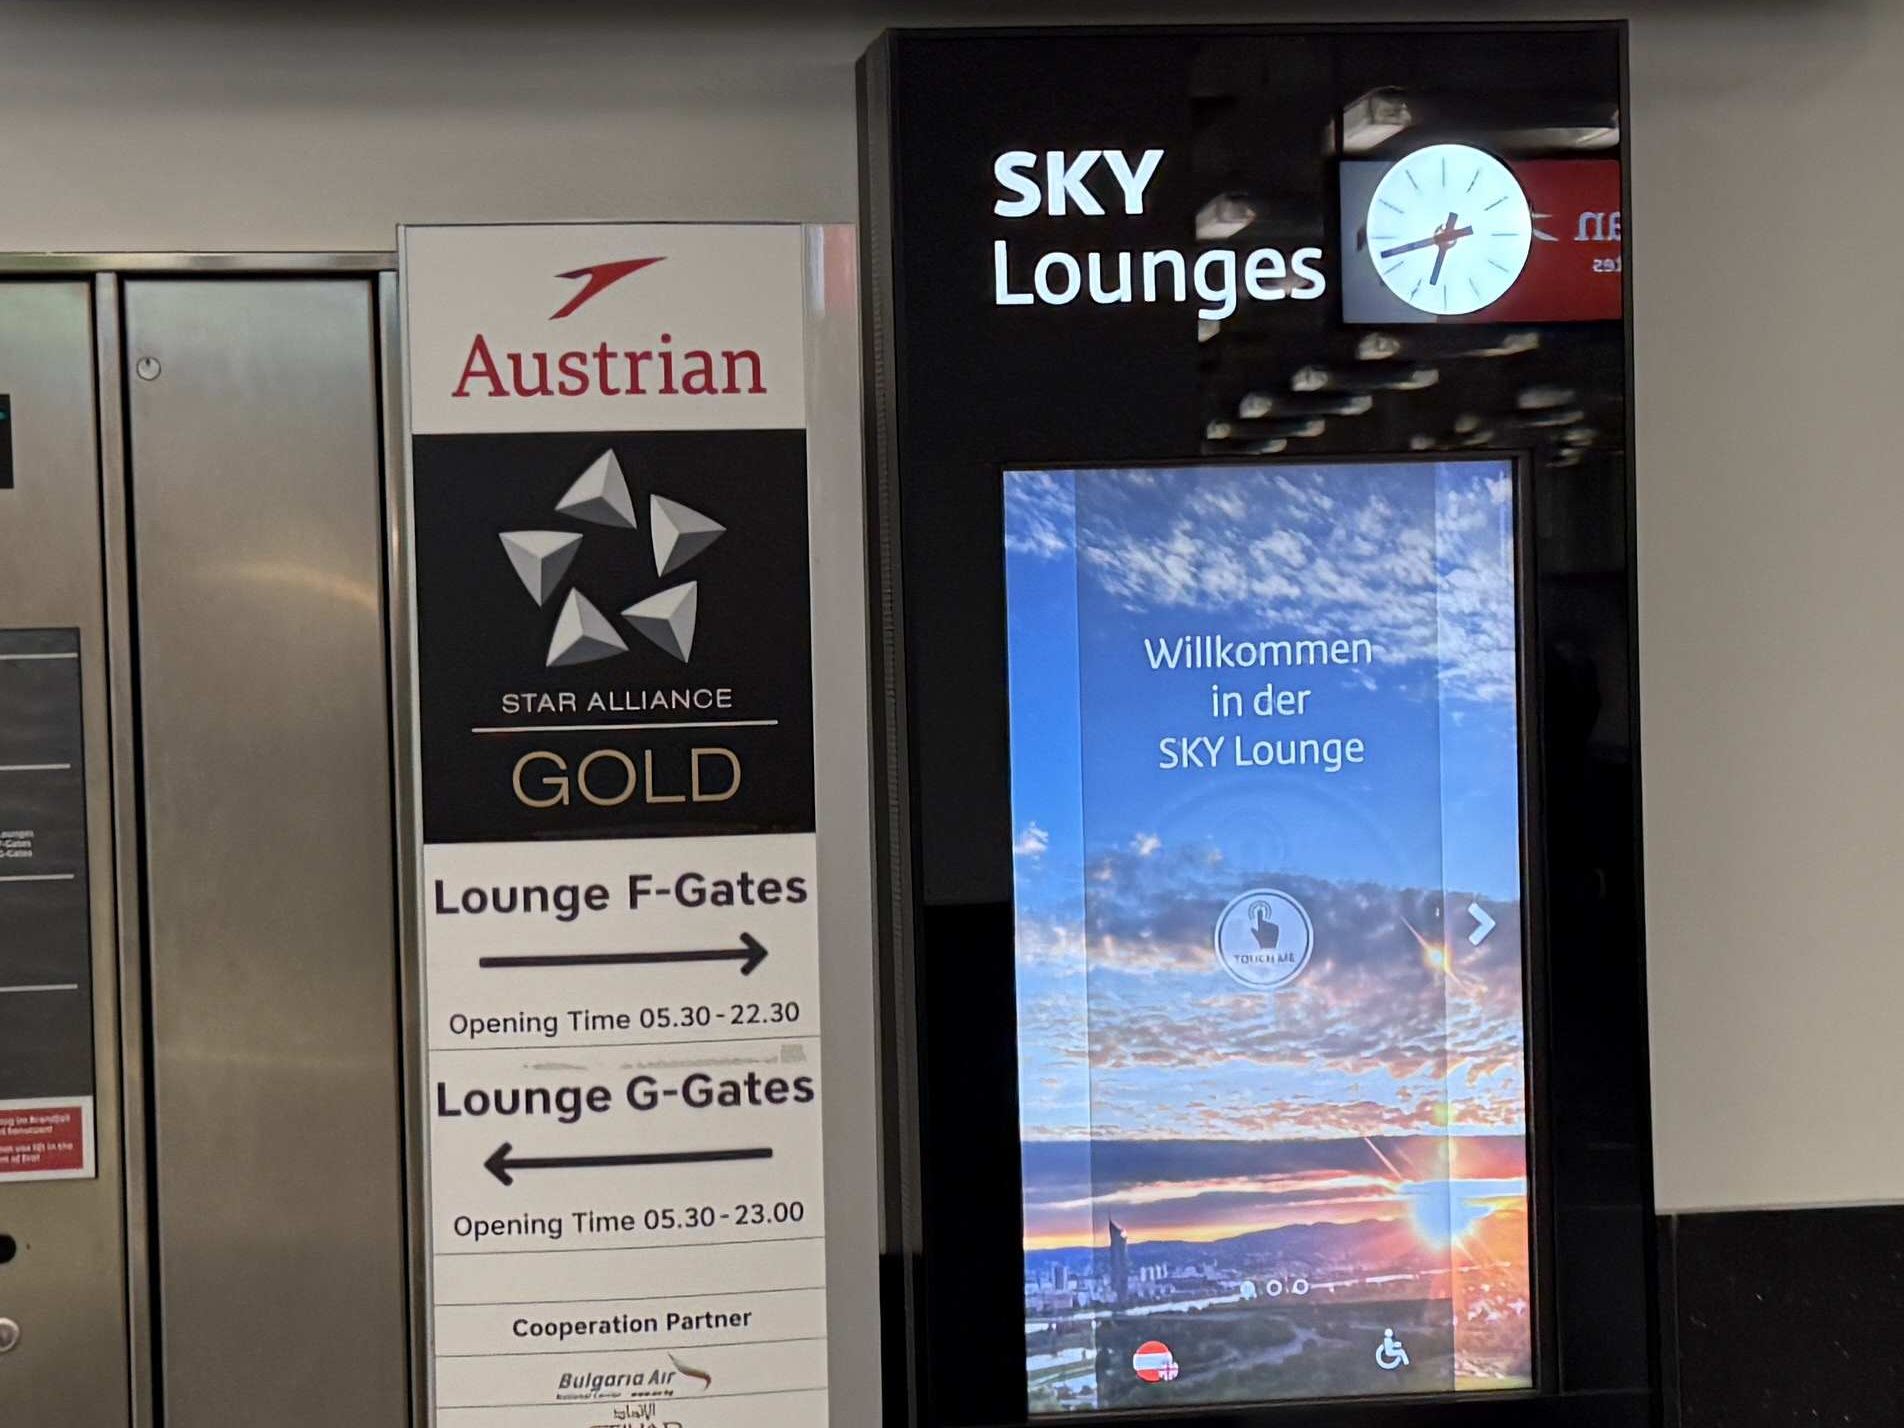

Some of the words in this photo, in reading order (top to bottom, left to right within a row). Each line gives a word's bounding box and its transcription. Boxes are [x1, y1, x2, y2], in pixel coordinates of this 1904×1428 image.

[992, 148, 1165, 219] SKY
[993, 239, 1326, 322] Lounges
[451, 332, 767, 398] Austrian
[1144, 634, 1374, 671] Willkommen
[502, 692, 577, 715] STAR
[587, 687, 733, 712] ALLIANCE
[1210, 684, 1243, 719] in
[1252, 683, 1312, 717] der
[1158, 737, 1226, 770] SKY
[1233, 734, 1366, 773] Lounge
[512, 746, 742, 808] GOLD
[434, 877, 610, 923] Lounge
[628, 871, 809, 910] F-Gates
[449, 1010, 559, 1039] Opening
[567, 1008, 632, 1032] Time
[436, 1080, 613, 1125] Lounge
[625, 1071, 816, 1112] G-Gates
[453, 1212, 563, 1242] Opening
[571, 1210, 636, 1234] Time
[512, 1313, 658, 1341] Cooperation
[665, 1309, 753, 1332] Partner
[558, 1371, 645, 1392] Bulgaria
[648, 1369, 677, 1386] Air
